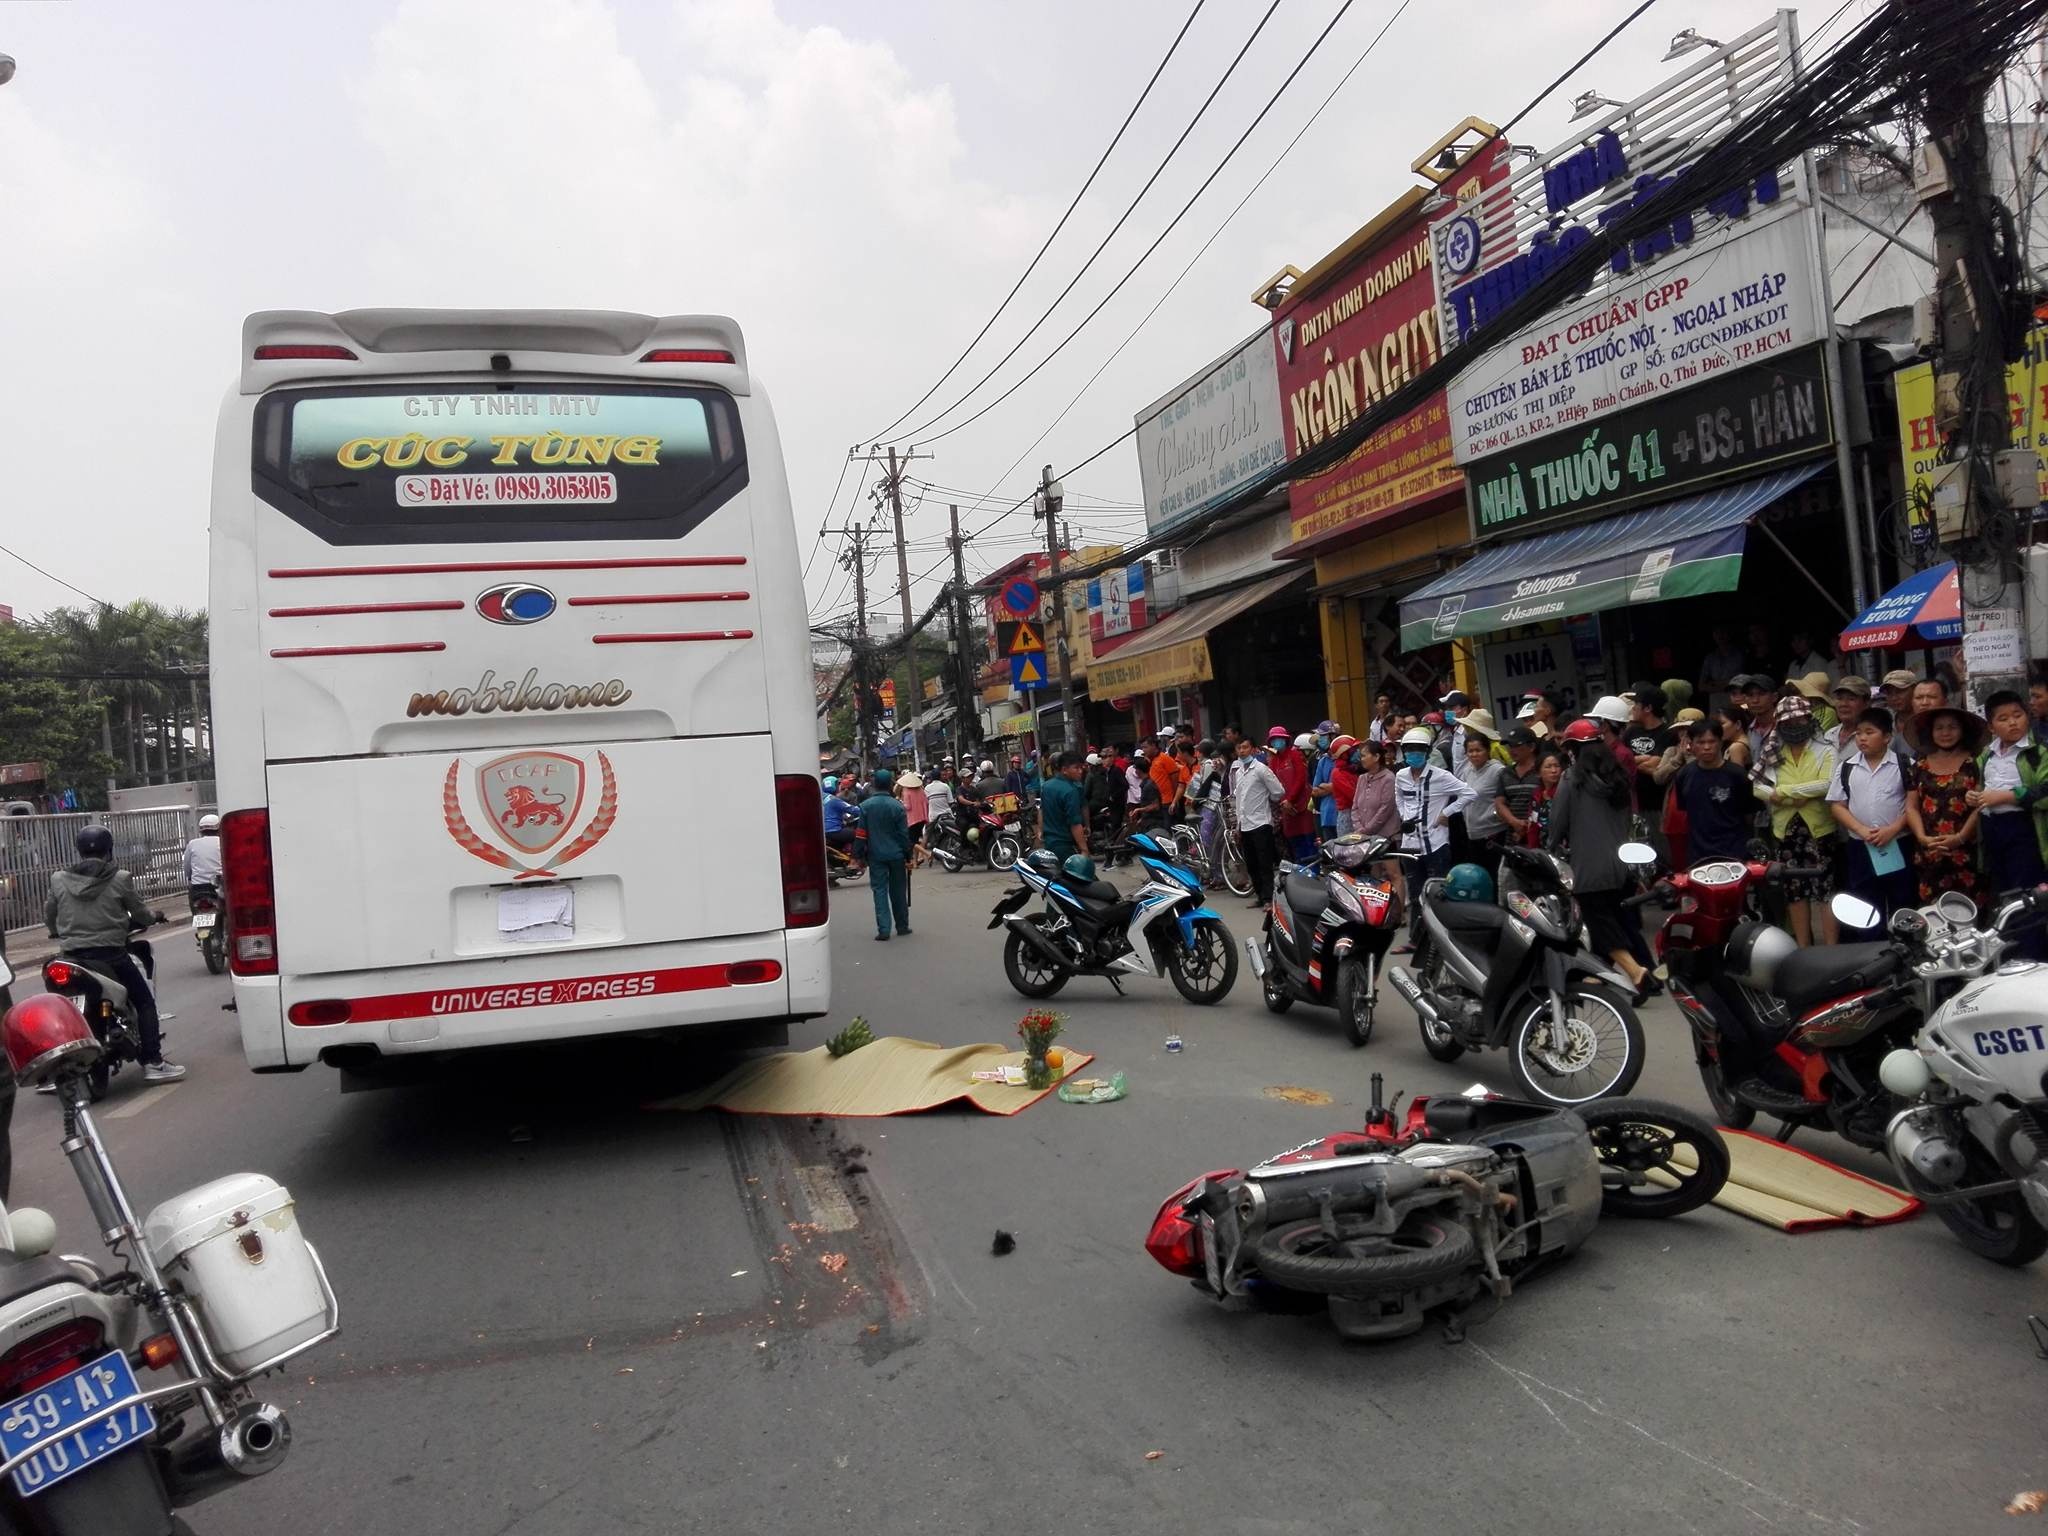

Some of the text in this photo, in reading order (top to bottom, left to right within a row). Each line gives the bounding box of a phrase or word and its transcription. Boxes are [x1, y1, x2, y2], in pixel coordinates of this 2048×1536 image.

[1301, 307, 1332, 347] DNTN
[1333, 285, 1363, 325] KINH
[1366, 250, 1412, 304] DOANH
[1521, 277, 1689, 366] ĐẠT CHUẨN GPP
[1465, 381, 1516, 417] CHUYÊN
[1520, 367, 1549, 397] BÁN
[1553, 353, 1573, 384] LẺ
[1575, 331, 1626, 374] THUỐC
[1629, 323, 1655, 353] NỘI
[1673, 296, 1727, 336] NGOẠI
[1732, 272, 1786, 313] NHẬP
[1592, 392, 1616, 412] Bình
[1733, 328, 1791, 361] TP.HCM
[404, 395, 601, 416] C.TY TNHH MTV
[1291, 346, 1358, 456] NGÔN
[1523, 397, 1545, 416] THỊ
[1549, 385, 1576, 410] DIỆP
[1620, 362, 1638, 381] GP
[491, 430, 664, 467] TÙNG
[1478, 374, 1816, 527] NHÀ THUỐC 41 BS: HÂN
[430, 475, 612, 504] Đặt Vé: 0989.305305
[1512, 571, 1582, 600] Salonpas
[1505, 643, 1556, 678] NHÀ
[406, 667, 632, 718] mobihome
[1973, 1024, 2046, 1057] CSGT
